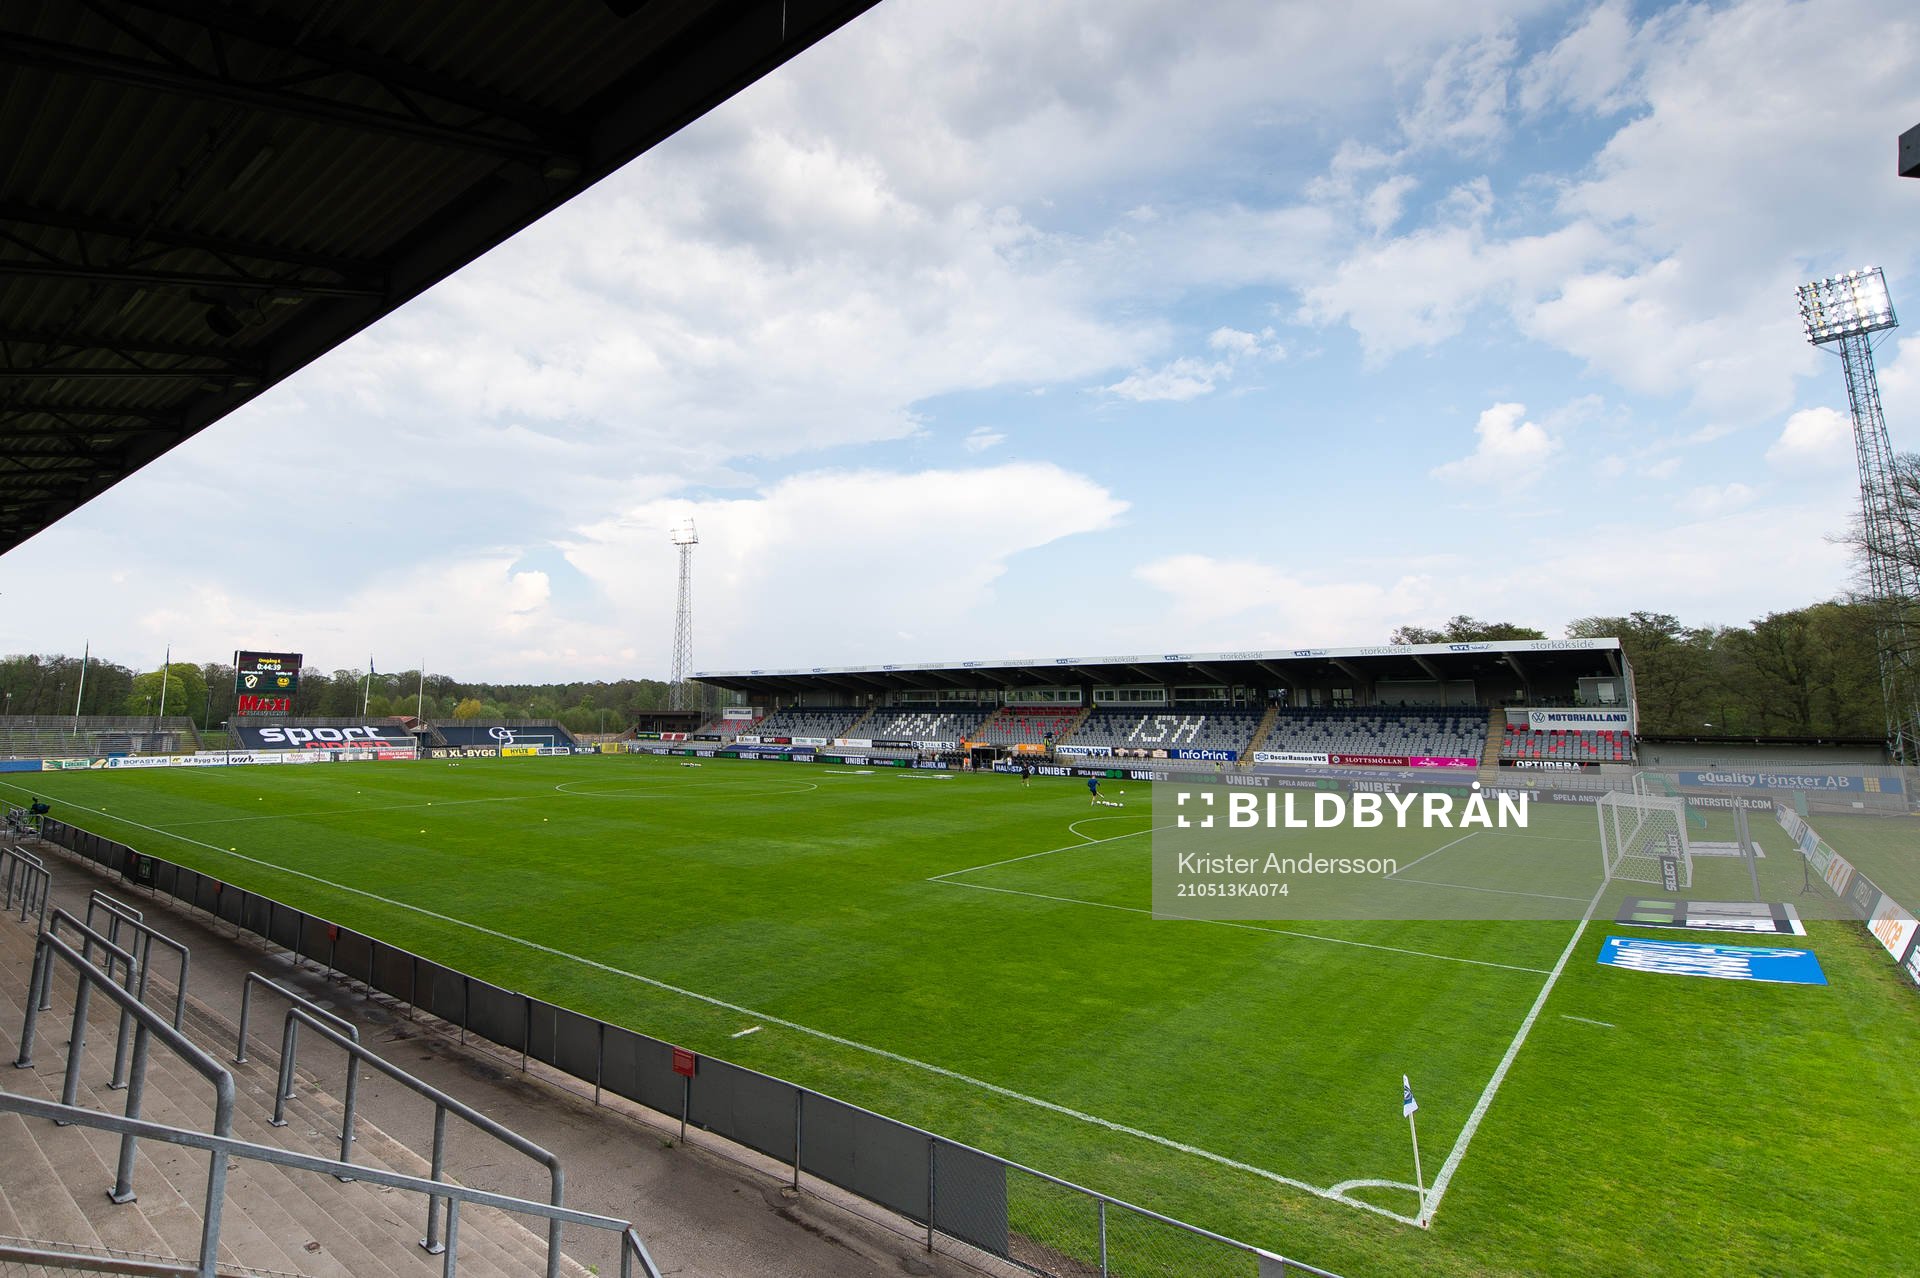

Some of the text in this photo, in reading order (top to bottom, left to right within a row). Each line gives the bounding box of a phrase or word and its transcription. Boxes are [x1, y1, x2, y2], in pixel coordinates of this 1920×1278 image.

[238, 695, 291, 711] MAXI
[1548, 713, 1628, 722] MOTORHALLAND
[259, 726, 386, 746] sport
[449, 749, 497, 758] XL-BYGG
[792, 754, 815, 762] UNIBET
[845, 757, 869, 766] UNIBET
[1313, 755, 1327, 763] VVS
[1345, 757, 1403, 765] SLOTTSMÖLLAN
[1516, 760, 1582, 771] OPTIMERA
[1038, 766, 1072, 776] UNIBET
[1130, 771, 1169, 781] UNIBET
[1697, 772, 1850, 787] eQuality Fönster AB
[1225, 775, 1270, 787] UNIBET
[1278, 779, 1296, 787] SPELA
[1553, 794, 1577, 802] SPELA
[1663, 860, 1678, 892] SELECT
